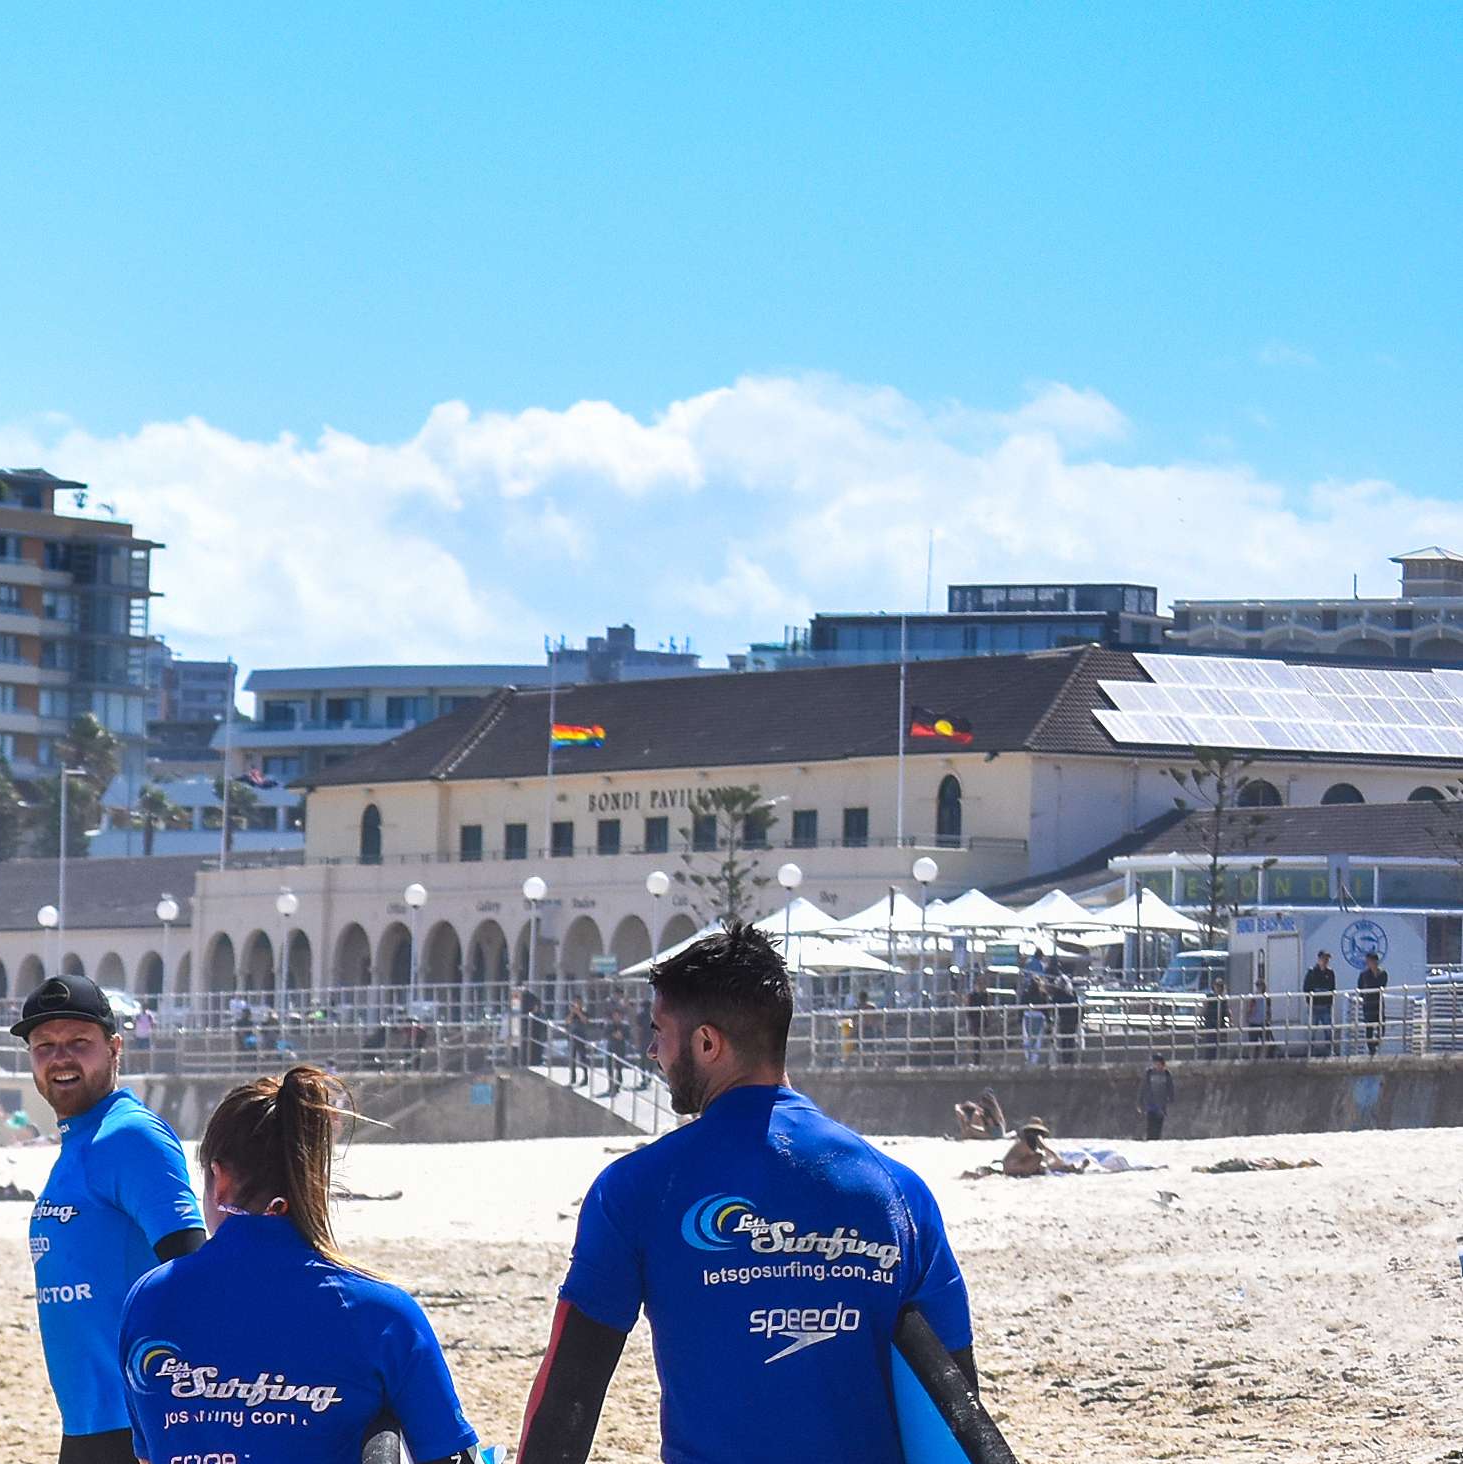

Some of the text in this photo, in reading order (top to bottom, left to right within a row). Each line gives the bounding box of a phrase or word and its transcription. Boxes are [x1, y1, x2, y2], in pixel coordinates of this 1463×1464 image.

[588, 791, 640, 812] BONDI
[751, 1221, 902, 1270] Surfing
[703, 1261, 894, 1286] letsgosurfing.com.au
[750, 1302, 861, 1339] speedo
[171, 1366, 343, 1413] Surfing
